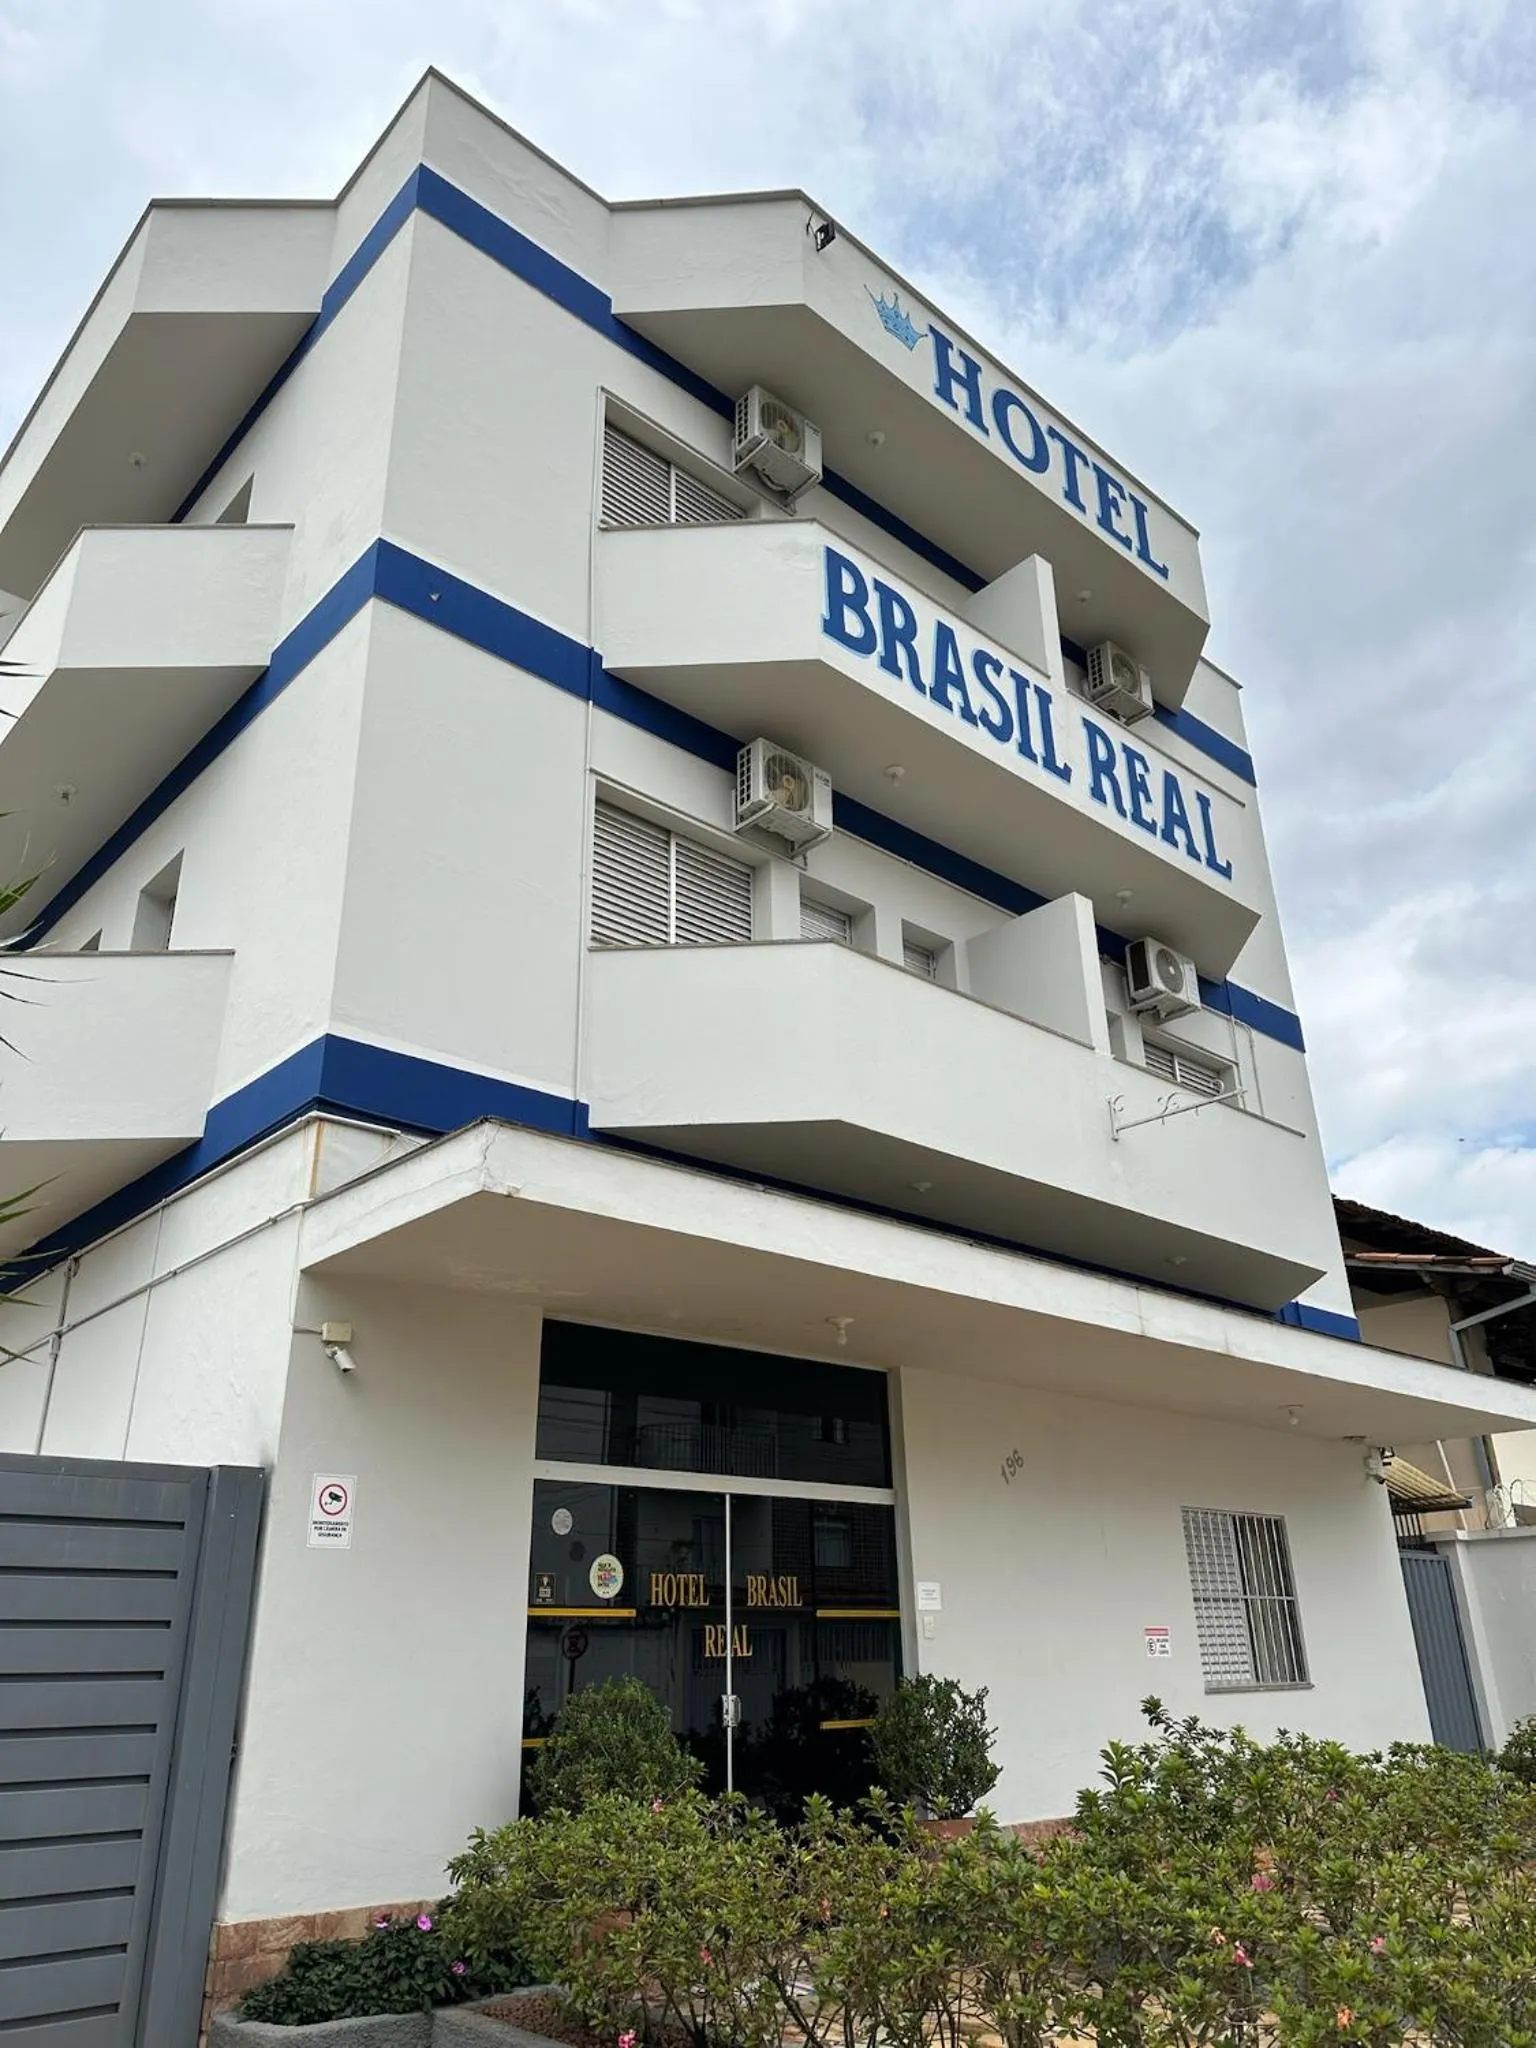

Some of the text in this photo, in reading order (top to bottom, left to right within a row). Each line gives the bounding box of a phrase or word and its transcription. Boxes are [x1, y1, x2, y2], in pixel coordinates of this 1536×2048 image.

[929, 326, 1169, 579] HOTEL
[822, 546, 1233, 880] BRASIL REAL
[1001, 1449, 1024, 1485] 196
[650, 1573, 710, 1607] HOTEL
[746, 1575, 803, 1607] BRASIL
[704, 1624, 753, 1657] REAL
